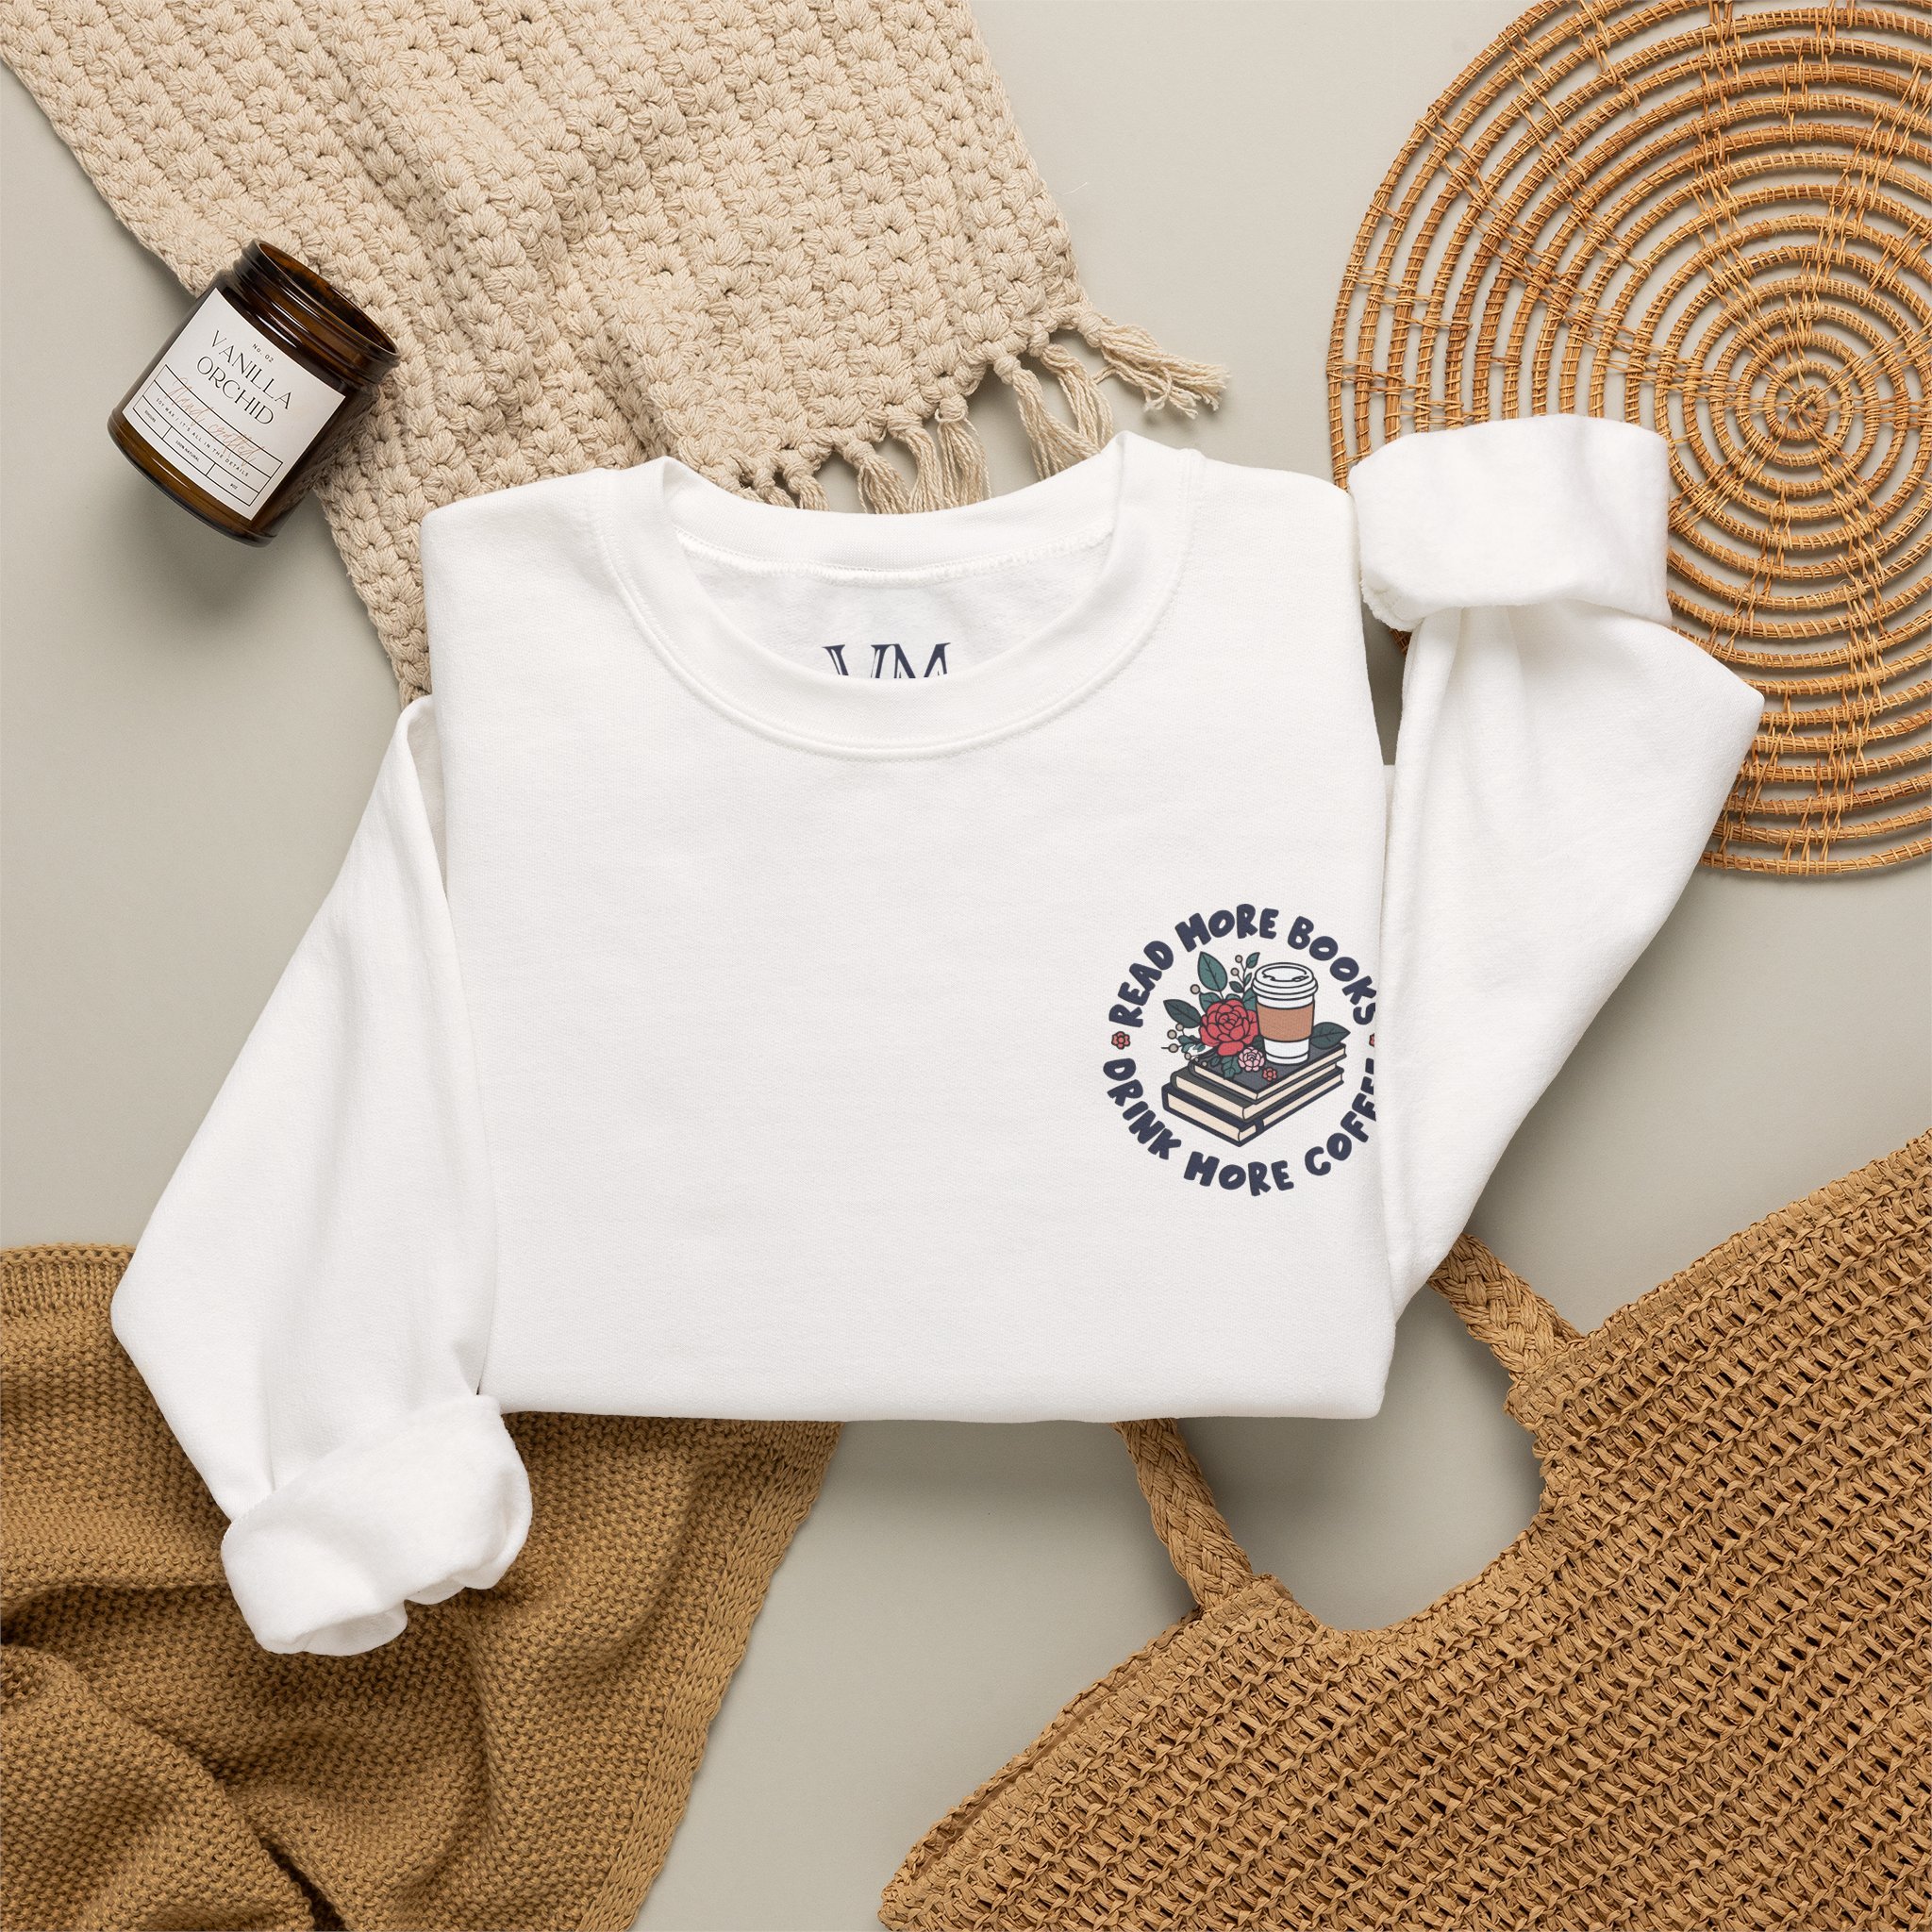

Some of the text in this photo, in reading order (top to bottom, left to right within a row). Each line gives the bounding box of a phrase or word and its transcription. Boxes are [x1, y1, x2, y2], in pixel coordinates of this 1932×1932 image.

[196, 356, 275, 425] ORCHID
[211, 330, 292, 409] VANILLA
[253, 343, 275, 363] No. 02
[156, 398, 164, 407] SOY
[165, 408, 175, 417] WAX
[179, 421, 191, 431] IT'S
[192, 432, 202, 441] ALL
[212, 448, 224, 458] THE
[225, 458, 249, 476] DETAILS
[1108, 903, 1377, 1028] READ MORE BOOKS
[1103, 1058, 1377, 1197] DRINK MORE COFF
